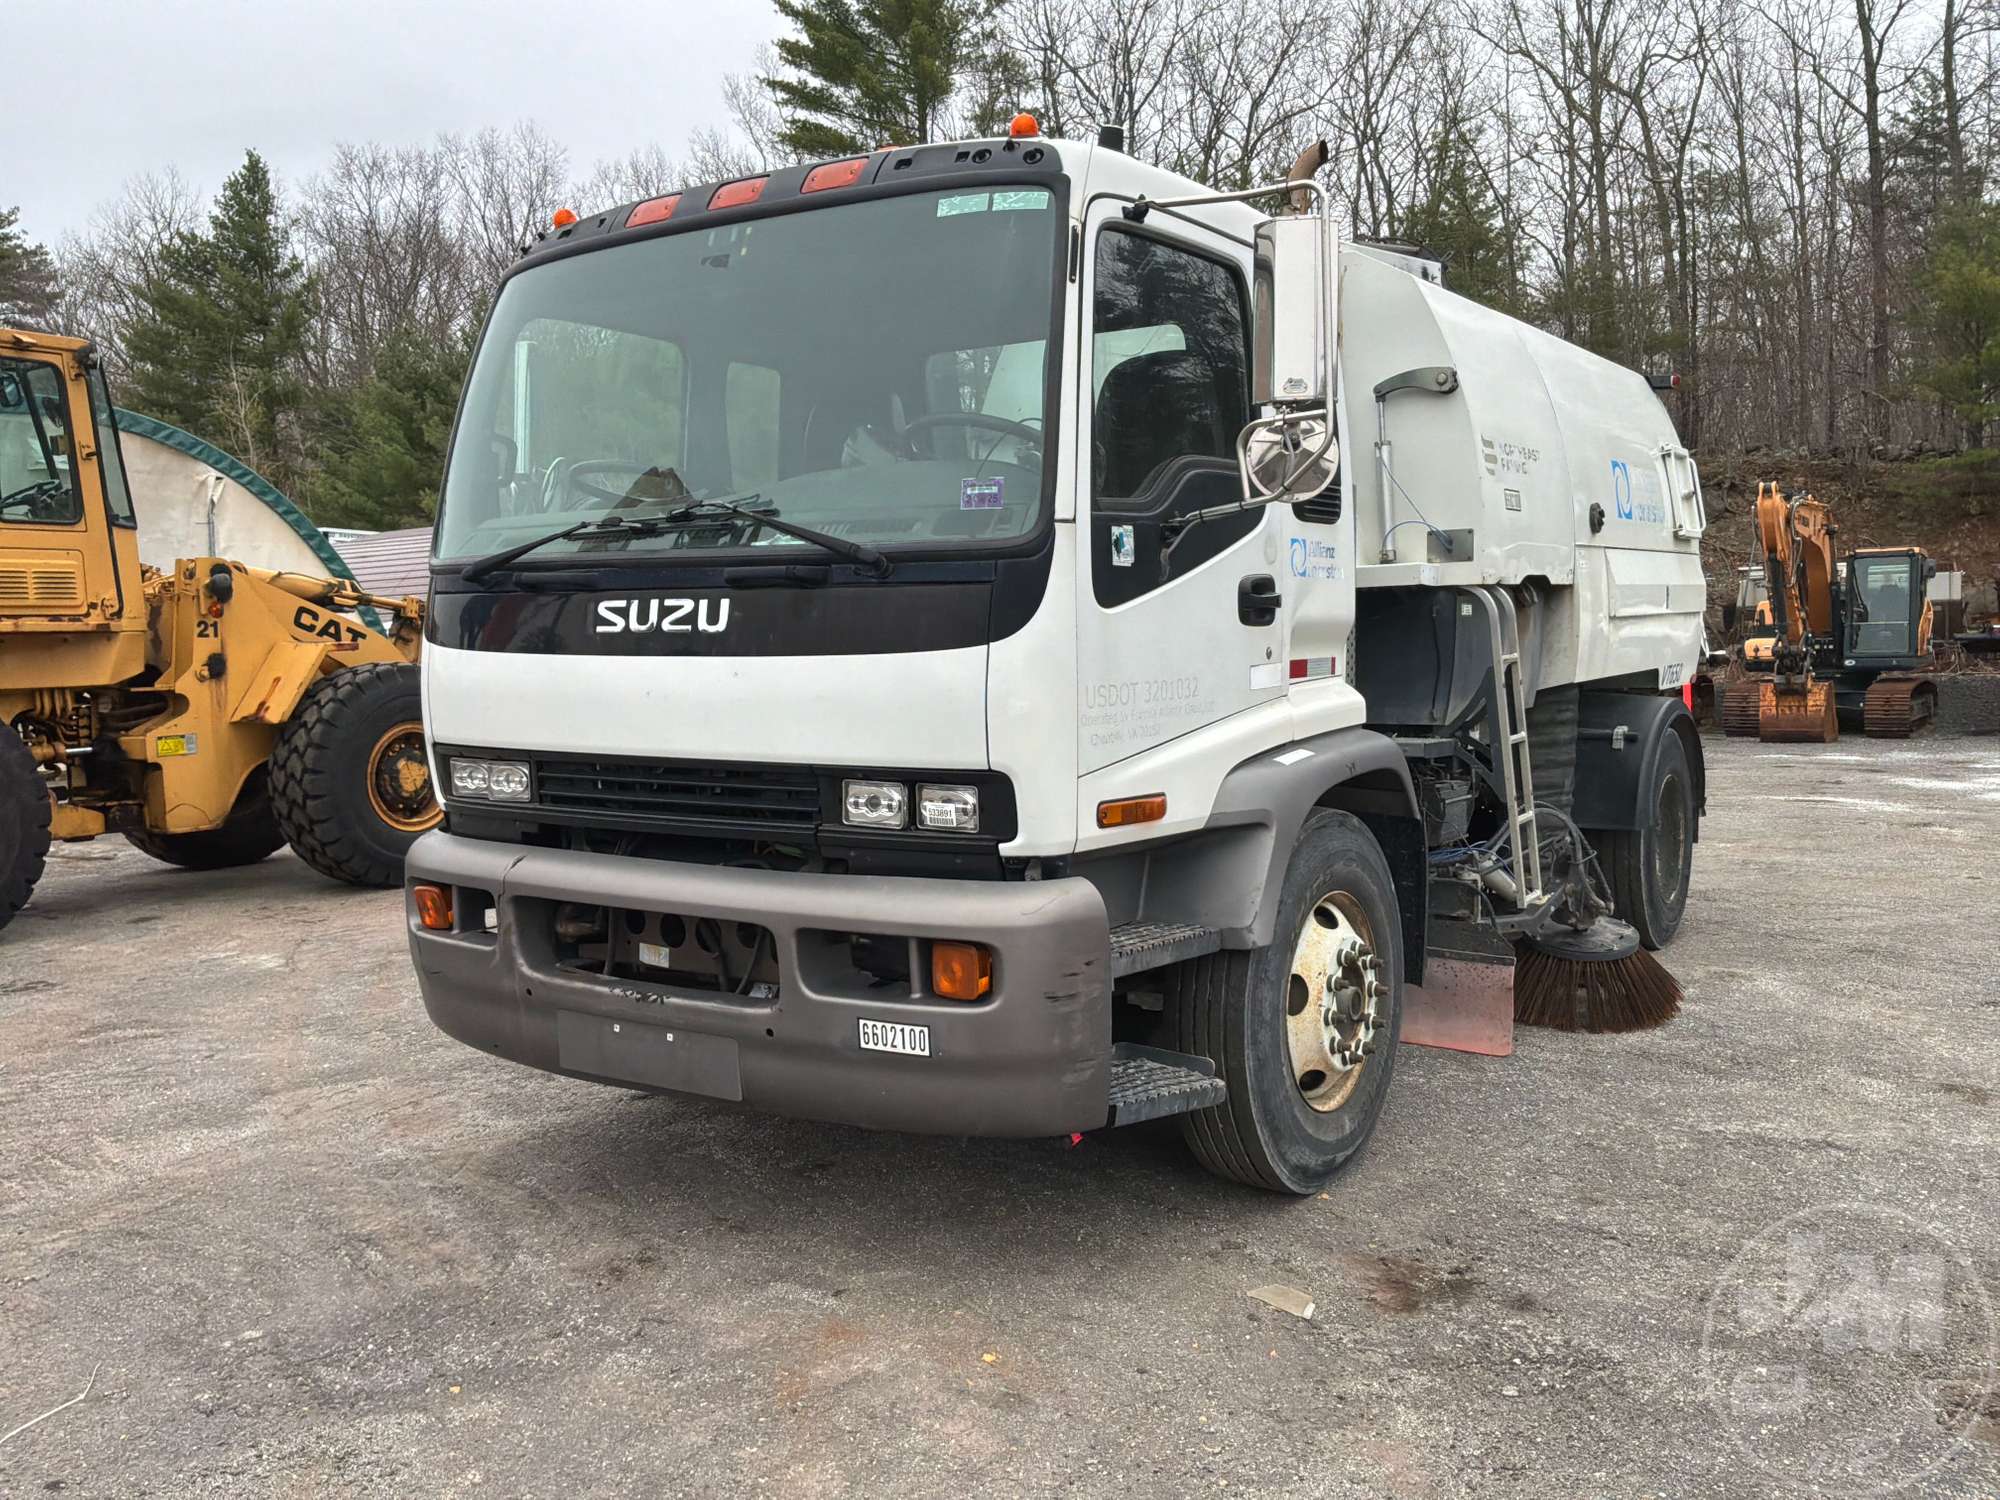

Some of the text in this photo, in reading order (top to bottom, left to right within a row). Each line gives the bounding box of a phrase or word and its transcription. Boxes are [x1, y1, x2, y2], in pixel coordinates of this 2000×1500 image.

[196, 620, 219, 638] 21
[293, 606, 367, 643] CAT
[1086, 676, 1199, 709] USDOT 3201032
[862, 1022, 926, 1052] 6602100
